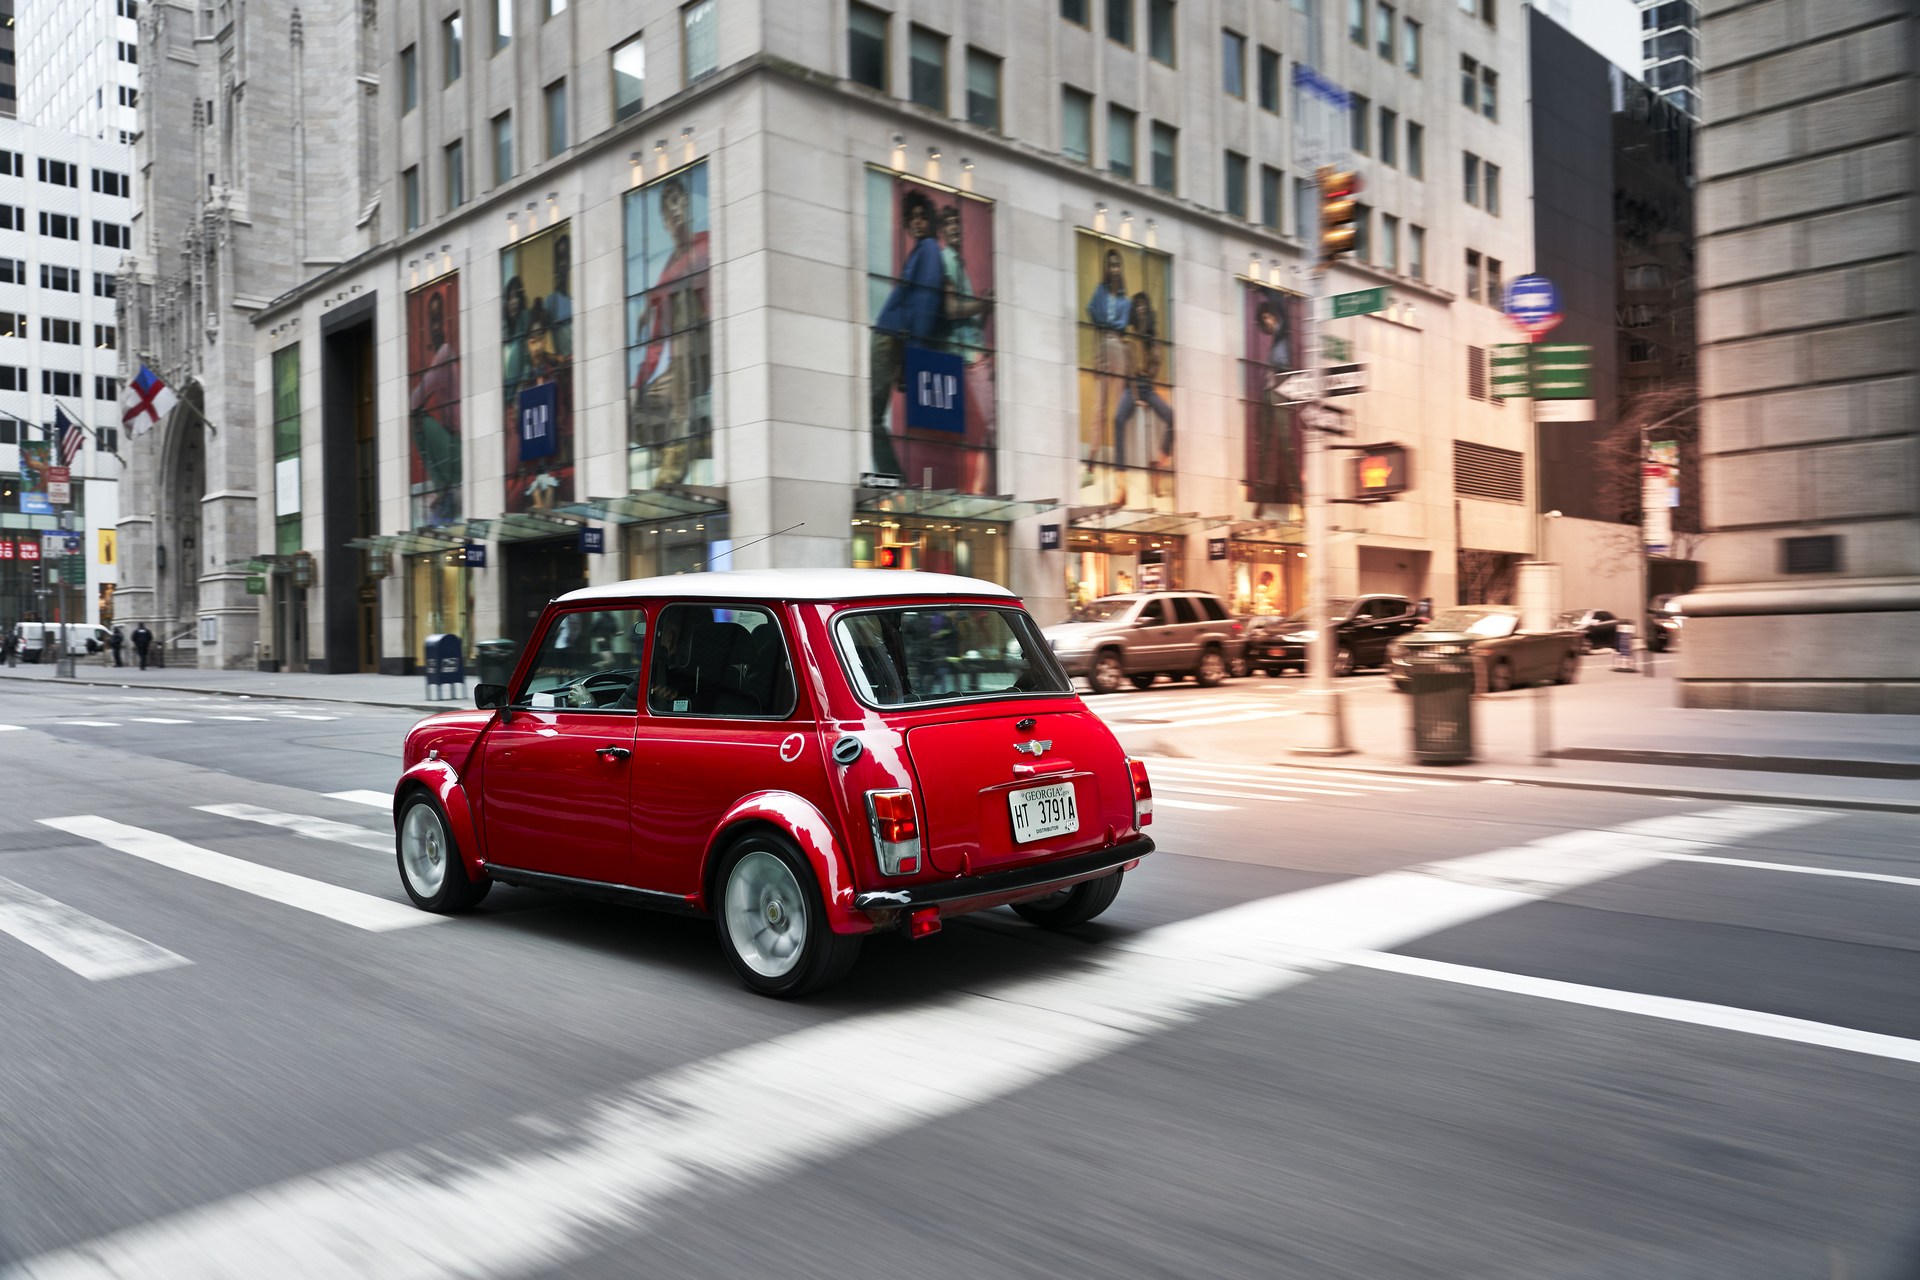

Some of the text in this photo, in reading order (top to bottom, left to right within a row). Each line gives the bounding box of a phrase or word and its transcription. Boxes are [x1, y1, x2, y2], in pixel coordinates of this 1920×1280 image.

[918, 370, 957, 409] GAP
[523, 404, 548, 440] GAP
[1014, 796, 1075, 829] HT 3791A
[1035, 825, 1059, 834] DISTRIBUTOR
